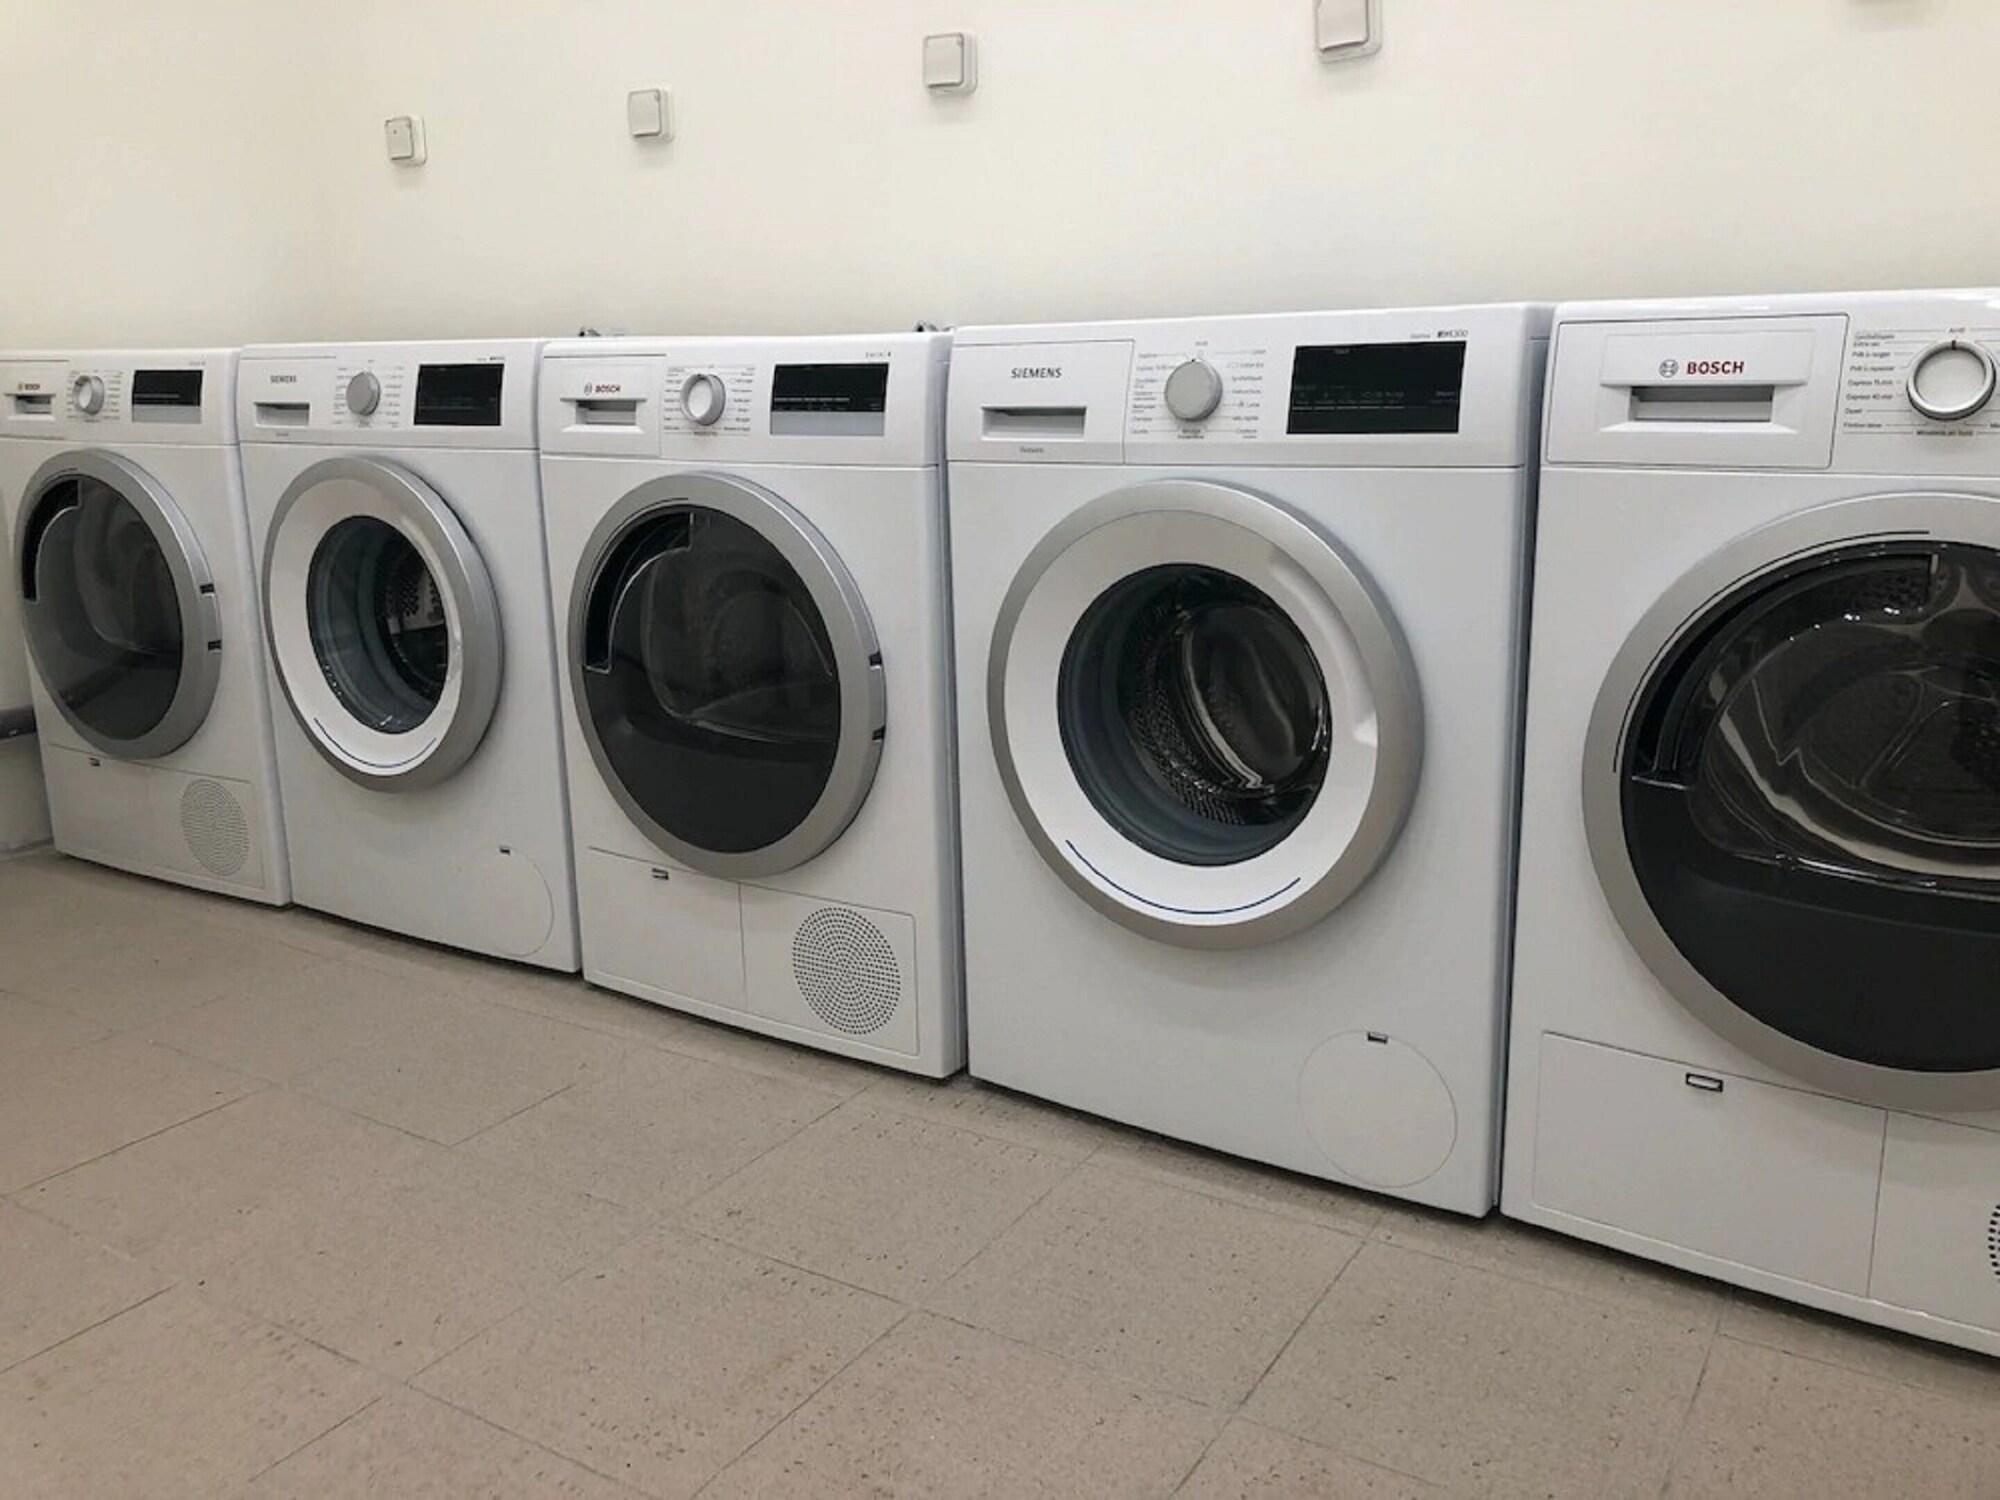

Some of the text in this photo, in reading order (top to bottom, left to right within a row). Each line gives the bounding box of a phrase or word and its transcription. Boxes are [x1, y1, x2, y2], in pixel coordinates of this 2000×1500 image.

[1011, 367, 1063, 379] SIEMENS
[1687, 361, 1744, 375] BOSCH
[595, 384, 621, 393] BOSCH
